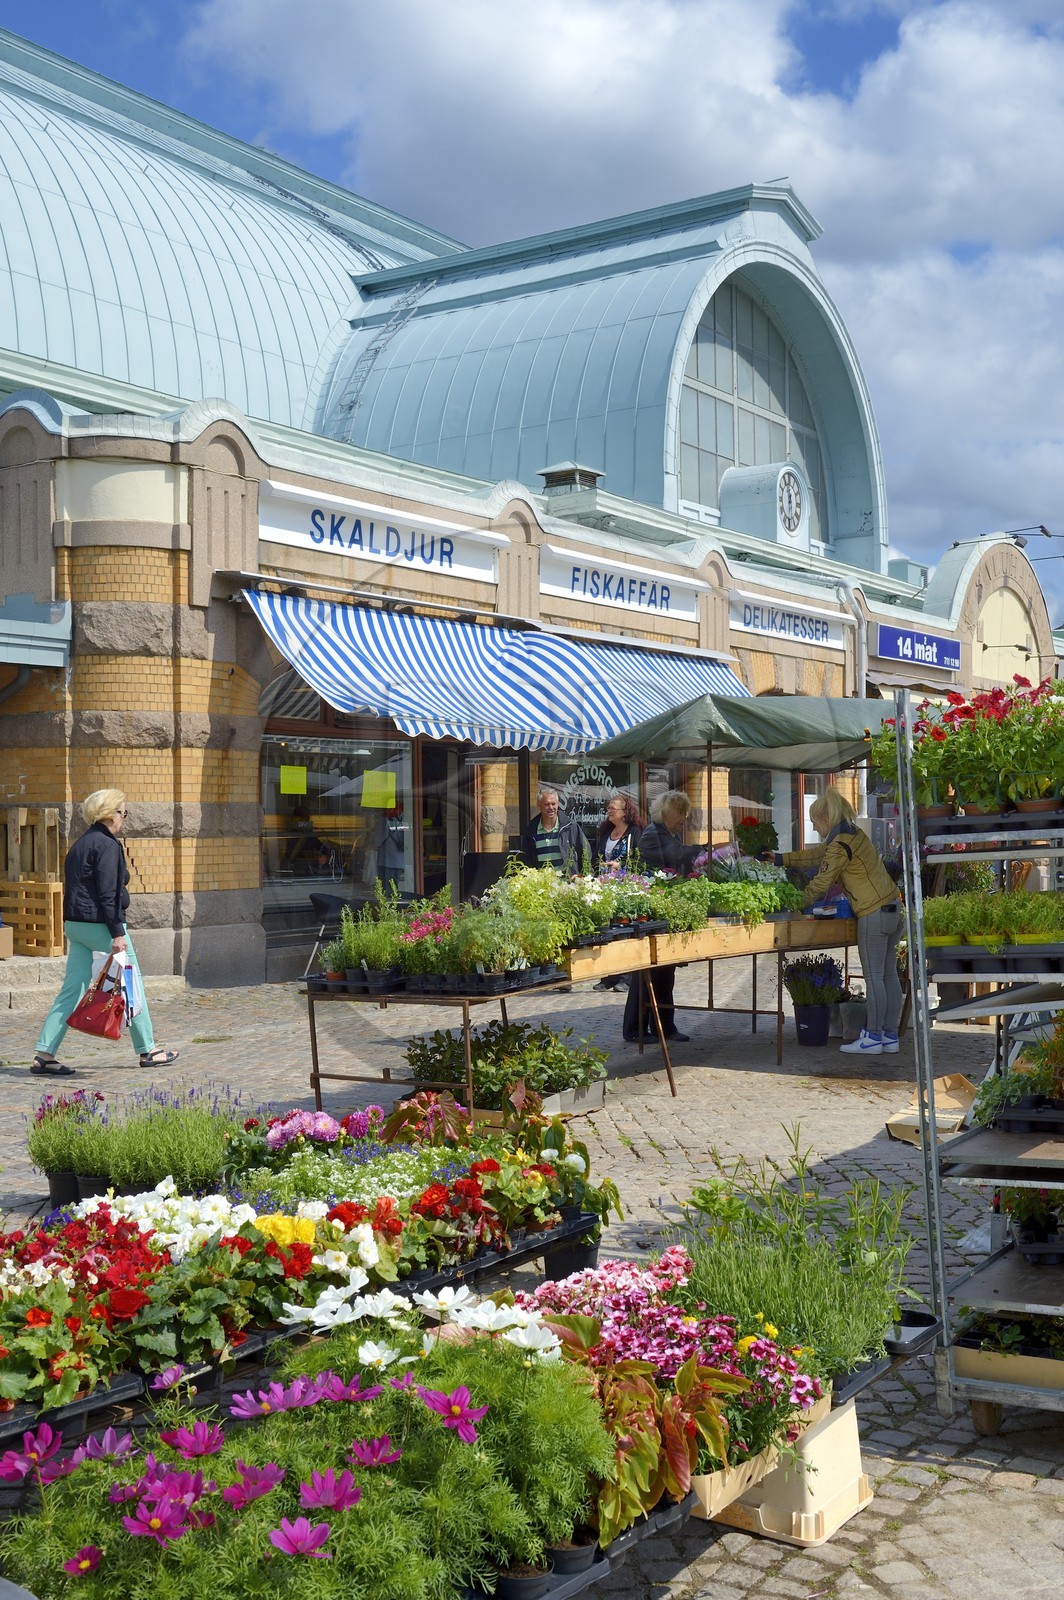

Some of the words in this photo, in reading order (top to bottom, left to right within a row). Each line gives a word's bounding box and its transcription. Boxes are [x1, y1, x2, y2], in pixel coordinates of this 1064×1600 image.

[310, 509, 454, 568] SKALDJUR
[571, 567, 670, 611] FISKAFFÄR
[743, 604, 829, 642] DELIKATESSER
[897, 636, 913, 658] 14
